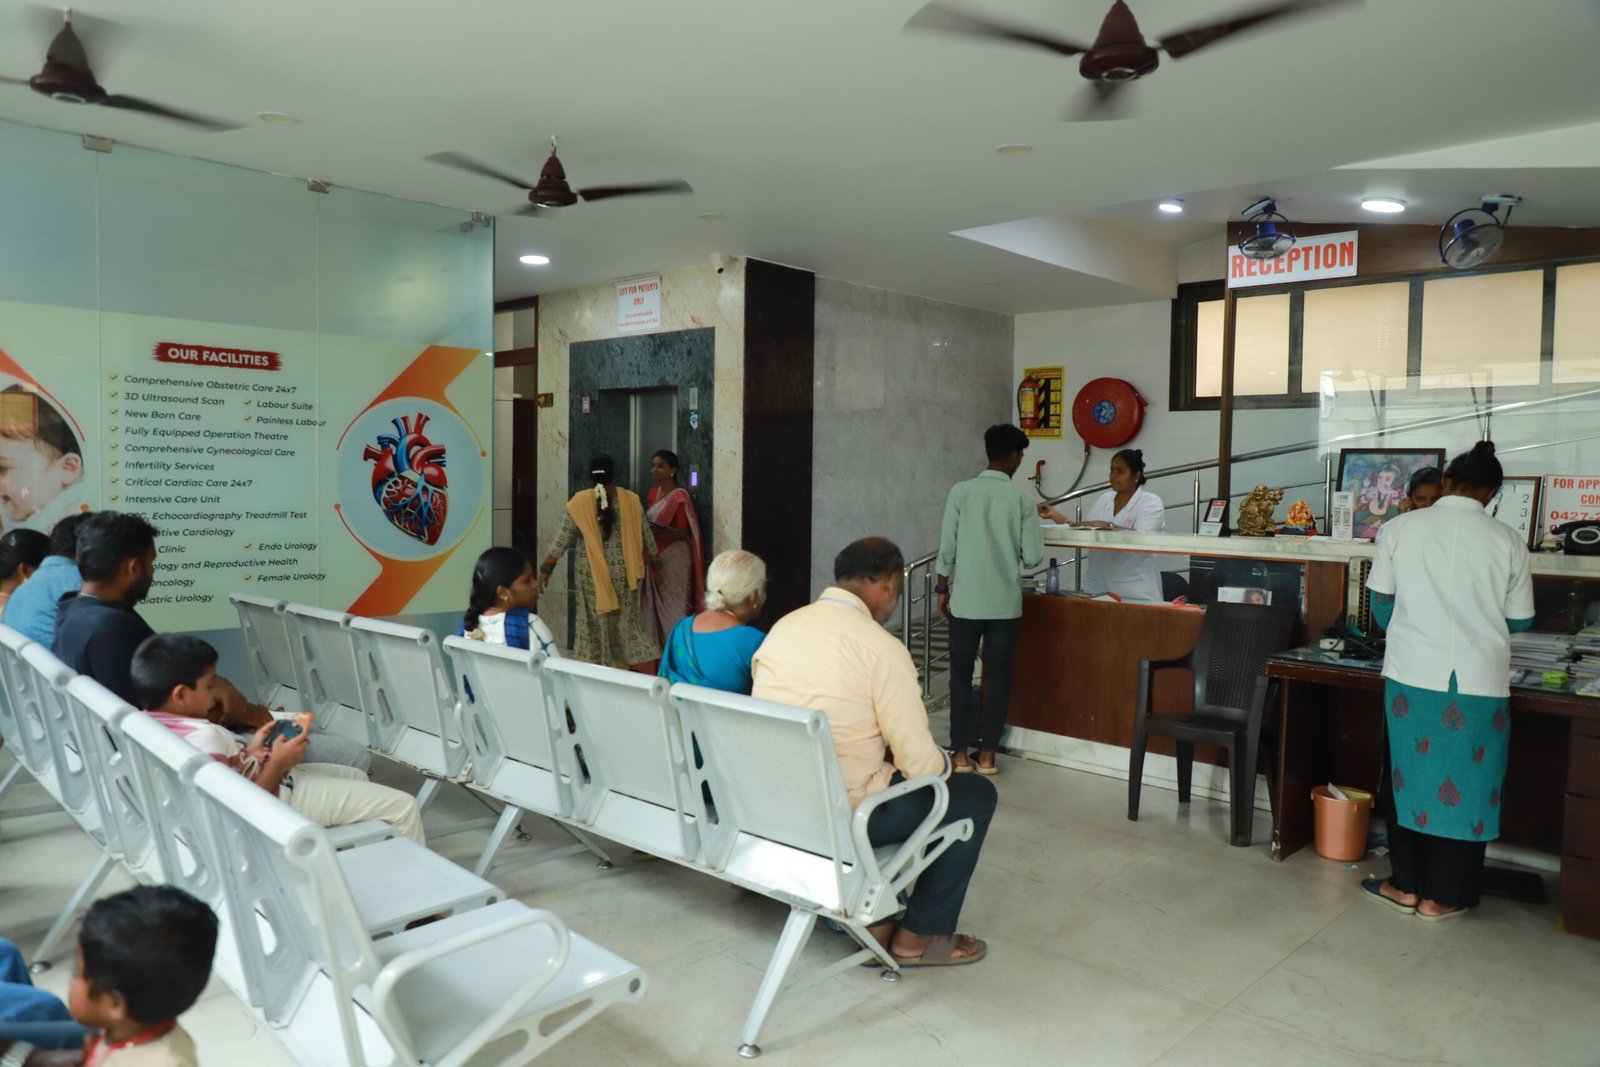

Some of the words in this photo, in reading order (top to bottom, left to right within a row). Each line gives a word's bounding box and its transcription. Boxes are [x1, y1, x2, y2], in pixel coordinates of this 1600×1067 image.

[1231, 241, 1354, 278] RECEPTION
[168, 348, 198, 361] OUR
[202, 350, 269, 366] FACILITIES
[124, 375, 204, 388] Comprehensive
[206, 381, 250, 391] Obstetric
[252, 384, 273, 392] Care
[275, 385, 296, 393] 24x7
[124, 392, 139, 400] 3D
[142, 394, 199, 404] Ultrasound
[201, 397, 224, 405] Scan
[257, 401, 289, 409] Labour
[291, 402, 313, 410] Suite
[125, 410, 149, 418] New
[151, 411, 175, 419] Born
[178, 412, 201, 421] Care
[256, 416, 293, 425] Painless
[296, 418, 326, 426] Labour
[125, 427, 149, 437] Fully
[152, 428, 201, 438] Equipped
[203, 430, 251, 439] Operation
[254, 432, 288, 440] Theatre
[125, 444, 204, 454] Comprehensive
[206, 447, 272, 457] Gynecological
[125, 461, 172, 471] Infertility
[175, 462, 214, 470] Services
[125, 478, 162, 486] Critical
[165, 479, 203, 487] Cardiac
[206, 479, 228, 487] Care
[1553, 478, 1574, 489] FOR
[125, 495, 172, 503] Intensive
[200, 495, 220, 503] Unit
[153, 512, 242, 521] Echocardiography
[245, 511, 288, 519] Treadmill
[158, 528, 180, 536] tive
[182, 528, 235, 537] Cardiology
[159, 545, 186, 553] Clinic
[284, 542, 318, 551] Urology
[181, 561, 201, 569] and
[203, 559, 266, 569] Reproductive
[268, 558, 298, 566] Health
[257, 574, 291, 582] Female
[293, 573, 327, 581] Urology
[176, 594, 214, 603] Urology
